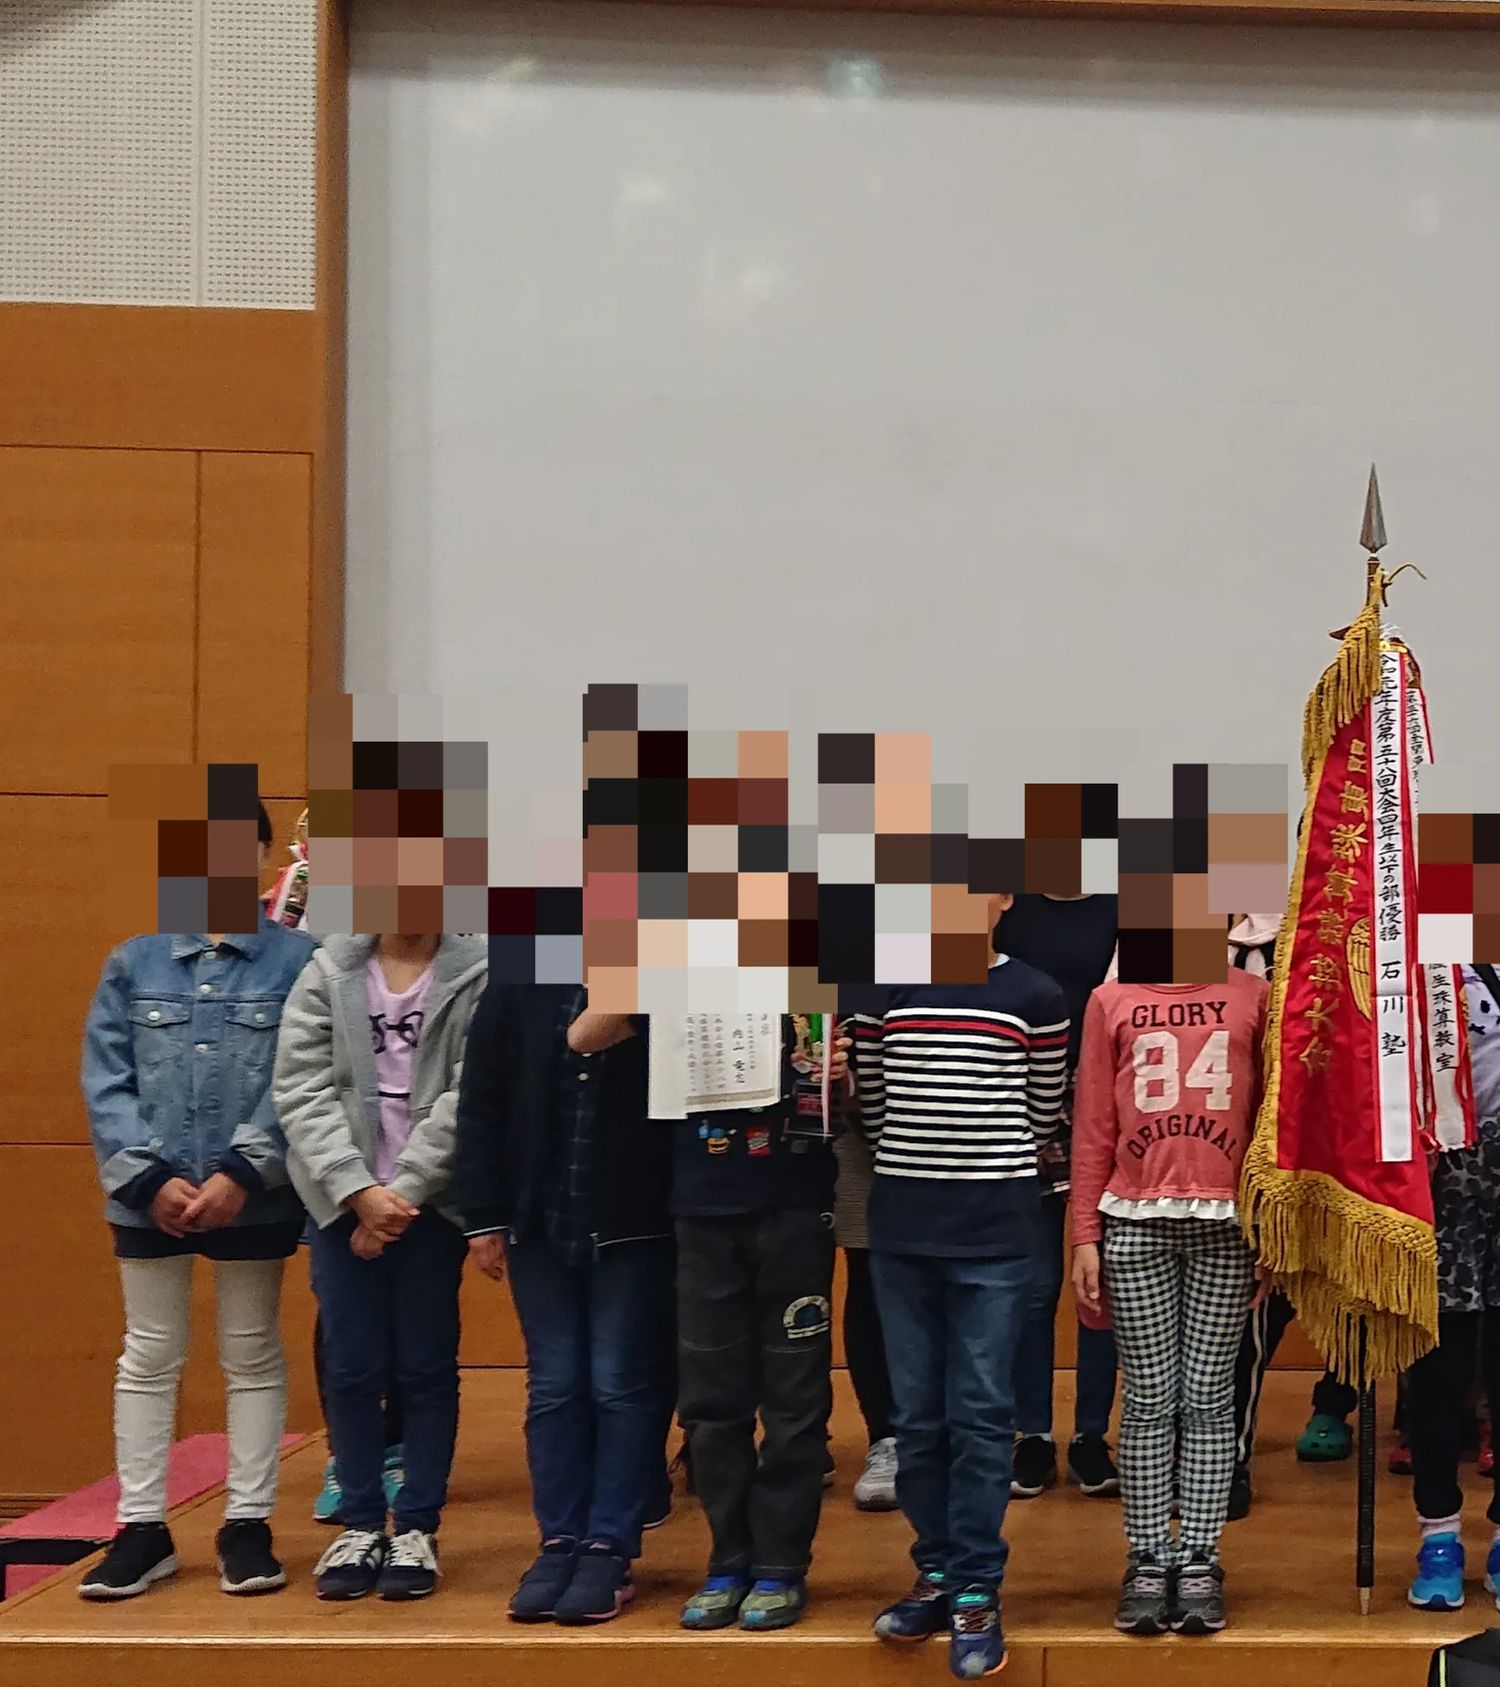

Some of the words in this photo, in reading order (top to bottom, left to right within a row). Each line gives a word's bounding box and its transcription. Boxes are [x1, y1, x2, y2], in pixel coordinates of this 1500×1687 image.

[1131, 1001, 1227, 1028] GLORY
[1380, 960, 1407, 1058] 石川塾
[1132, 1030, 1233, 1114] 84
[1126, 1113, 1237, 1160] ORIGINAL
